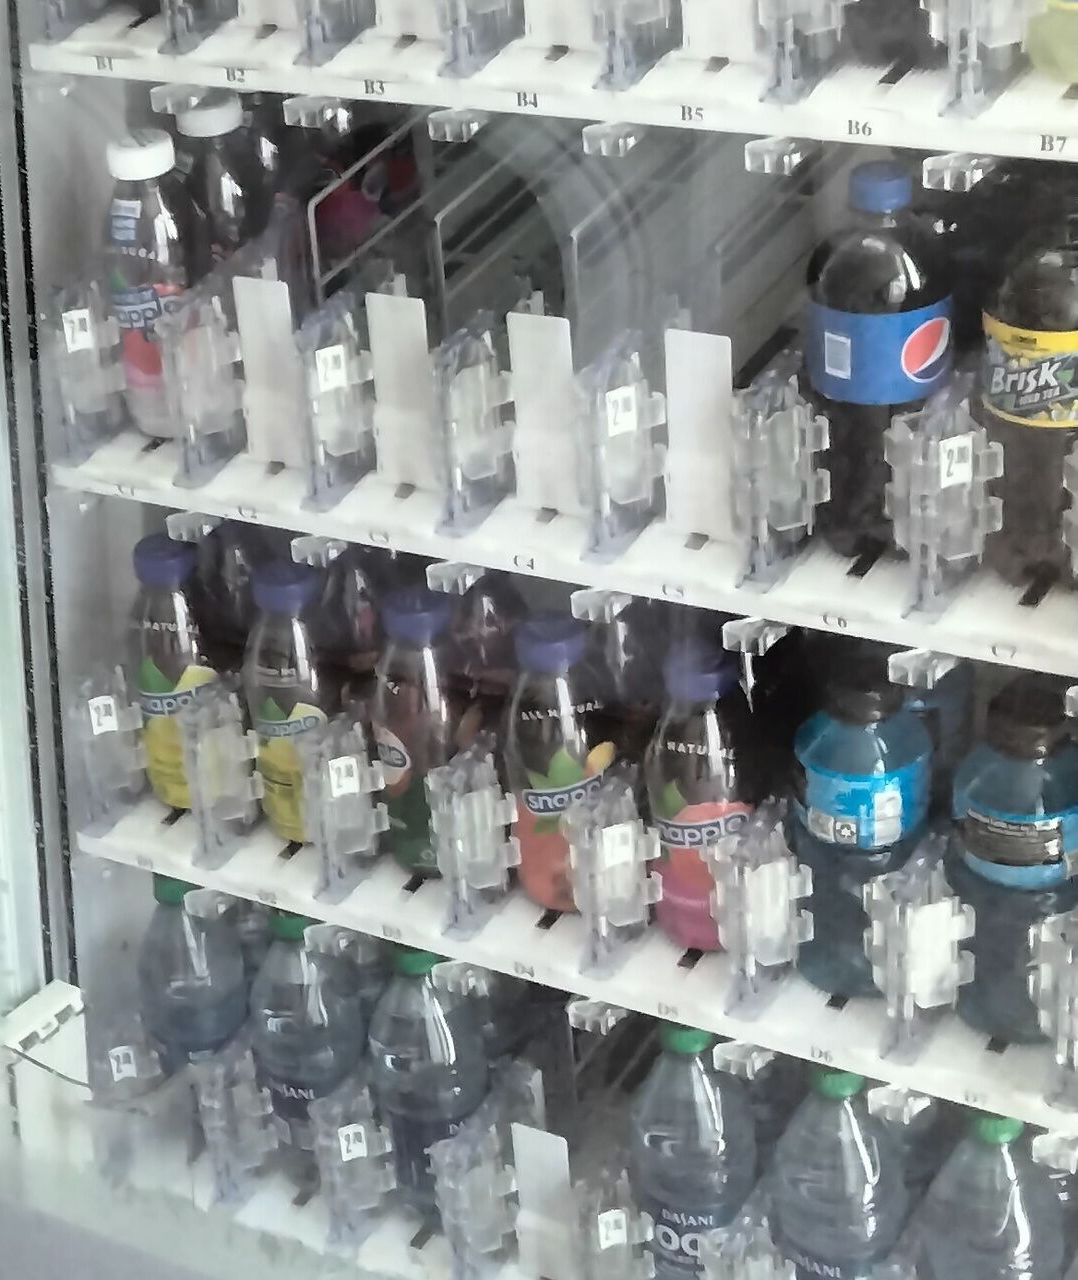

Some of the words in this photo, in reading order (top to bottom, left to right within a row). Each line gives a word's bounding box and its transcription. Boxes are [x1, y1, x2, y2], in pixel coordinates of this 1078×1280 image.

[364, 80, 385, 96] B3
[516, 91, 538, 108] B4
[680, 105, 703, 122] B5
[847, 119, 872, 138] B6
[1041, 135, 1067, 153] B7
[547, 700, 604, 719] NTURAL
[667, 741, 737, 760] NATUAL
